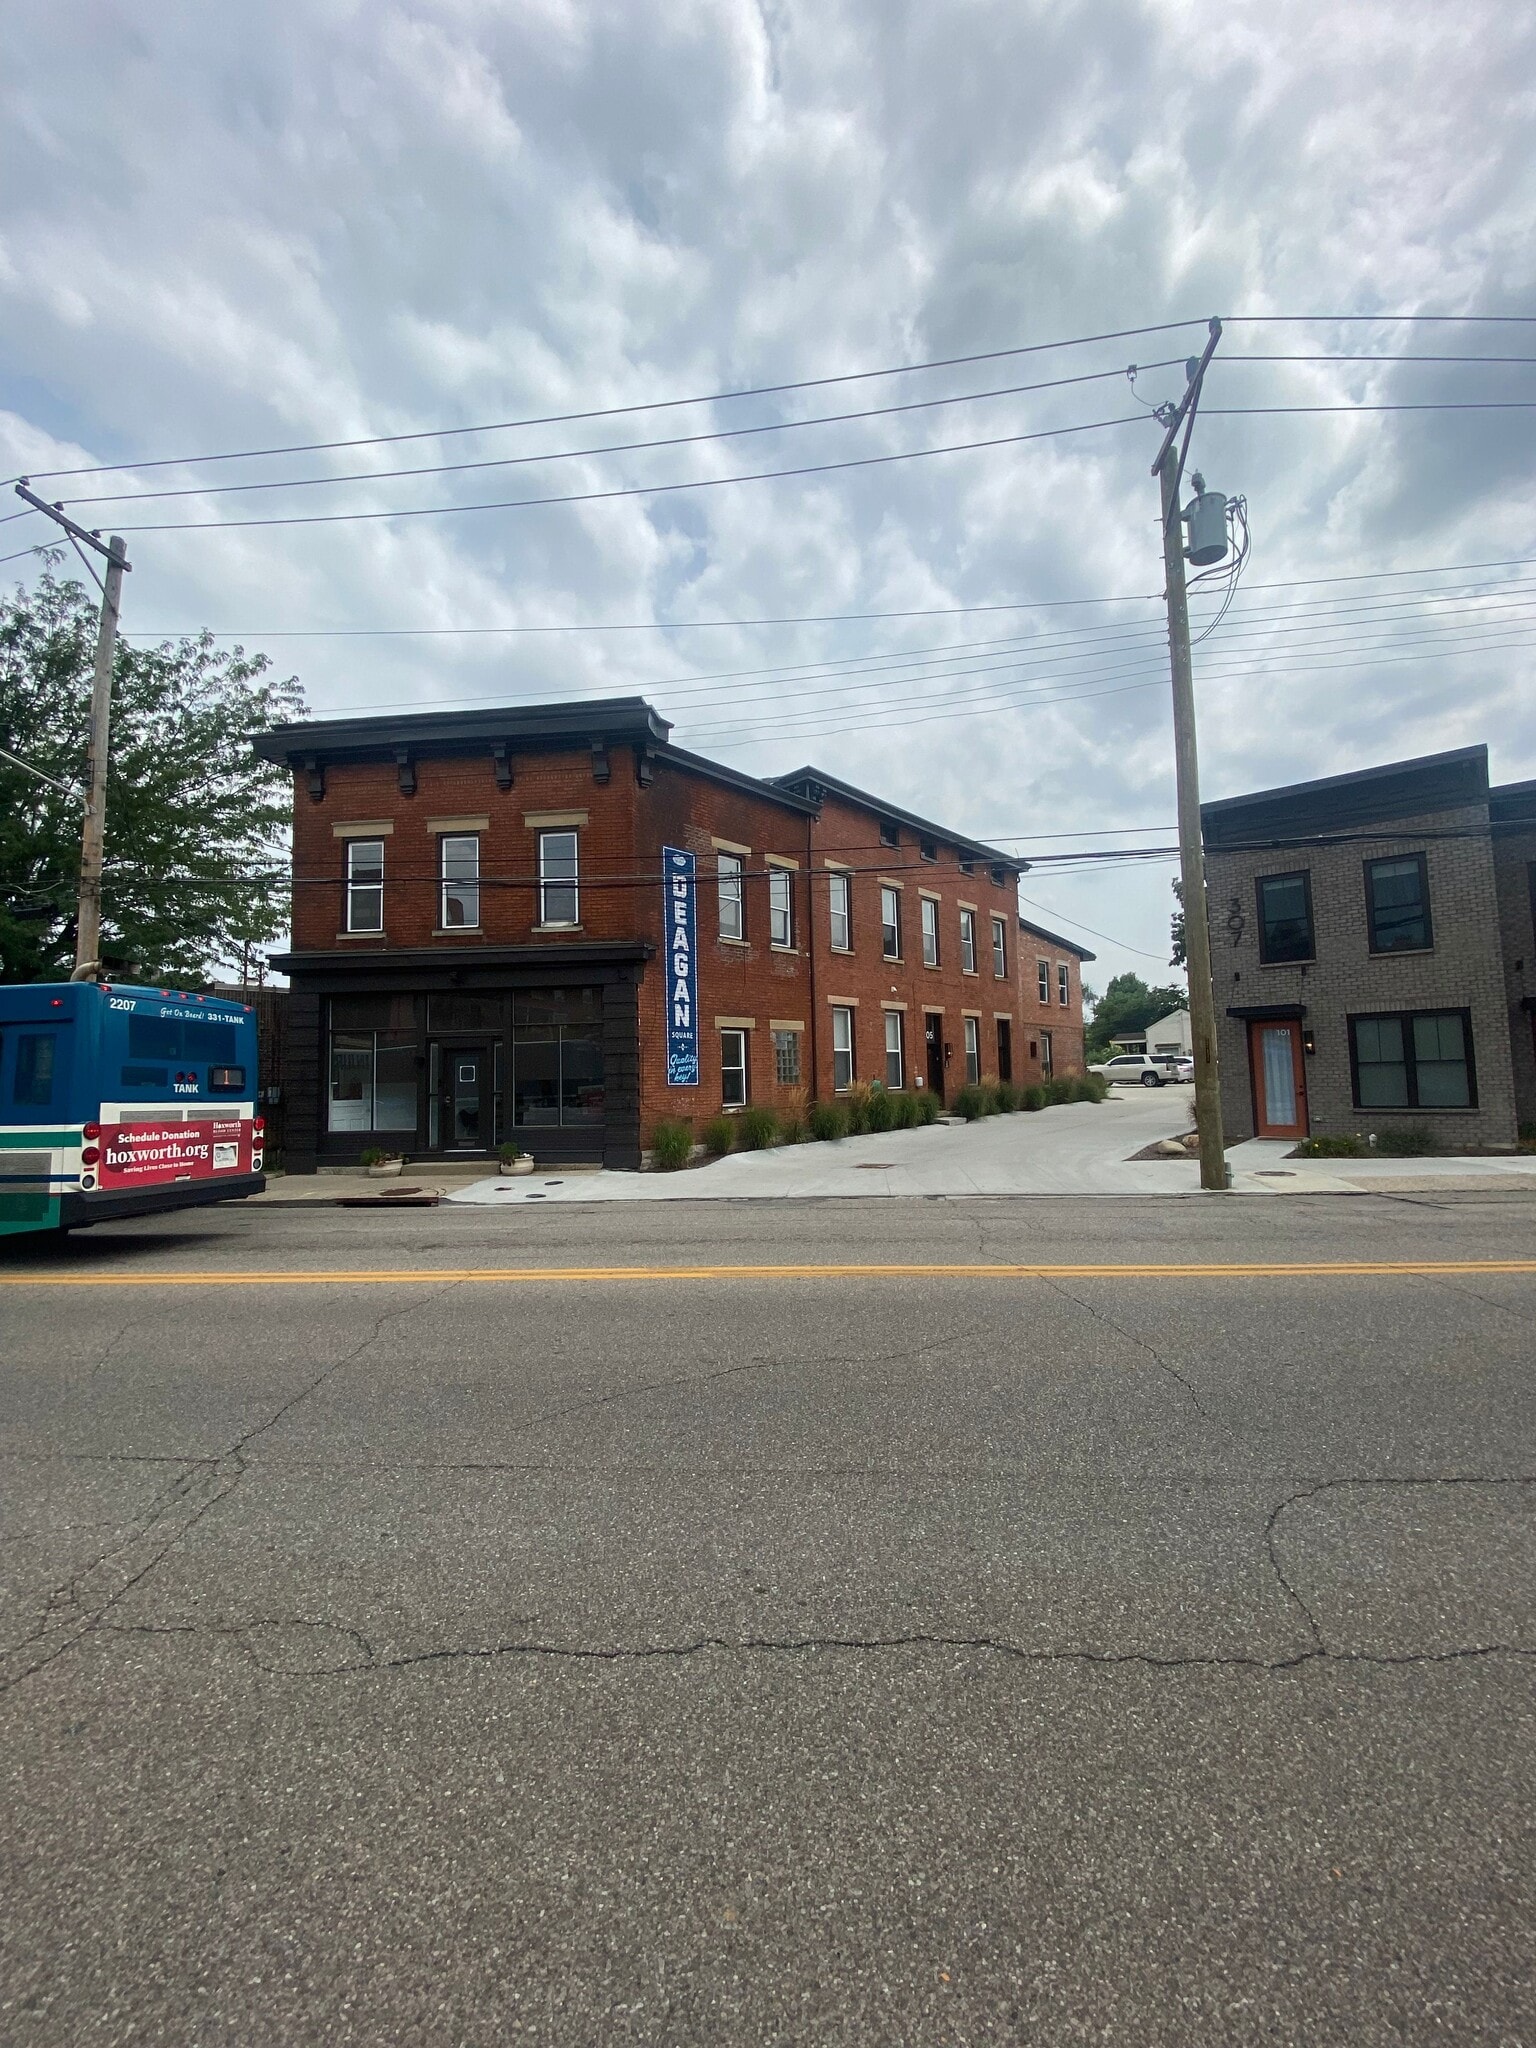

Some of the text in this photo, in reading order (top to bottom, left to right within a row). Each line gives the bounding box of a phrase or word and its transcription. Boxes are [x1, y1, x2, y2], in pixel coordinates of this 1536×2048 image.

[1228, 898, 1245, 947] 307
[672, 873, 690, 1027] DEAGAN
[109, 998, 137, 1012] 2207
[160, 1007, 173, 1018] Get
[174, 1009, 184, 1017] On
[207, 1013, 245, 1025] 331-TANK
[671, 1031, 694, 1039] SQUARE
[670, 1053, 698, 1067] Quality
[223, 1069, 230, 1085] 1
[173, 1083, 199, 1093] TANK
[118, 1129, 200, 1144] Schedule Donation
[105, 1143, 209, 1165] hoxworth.org
[123, 1166, 143, 1174] Saving
